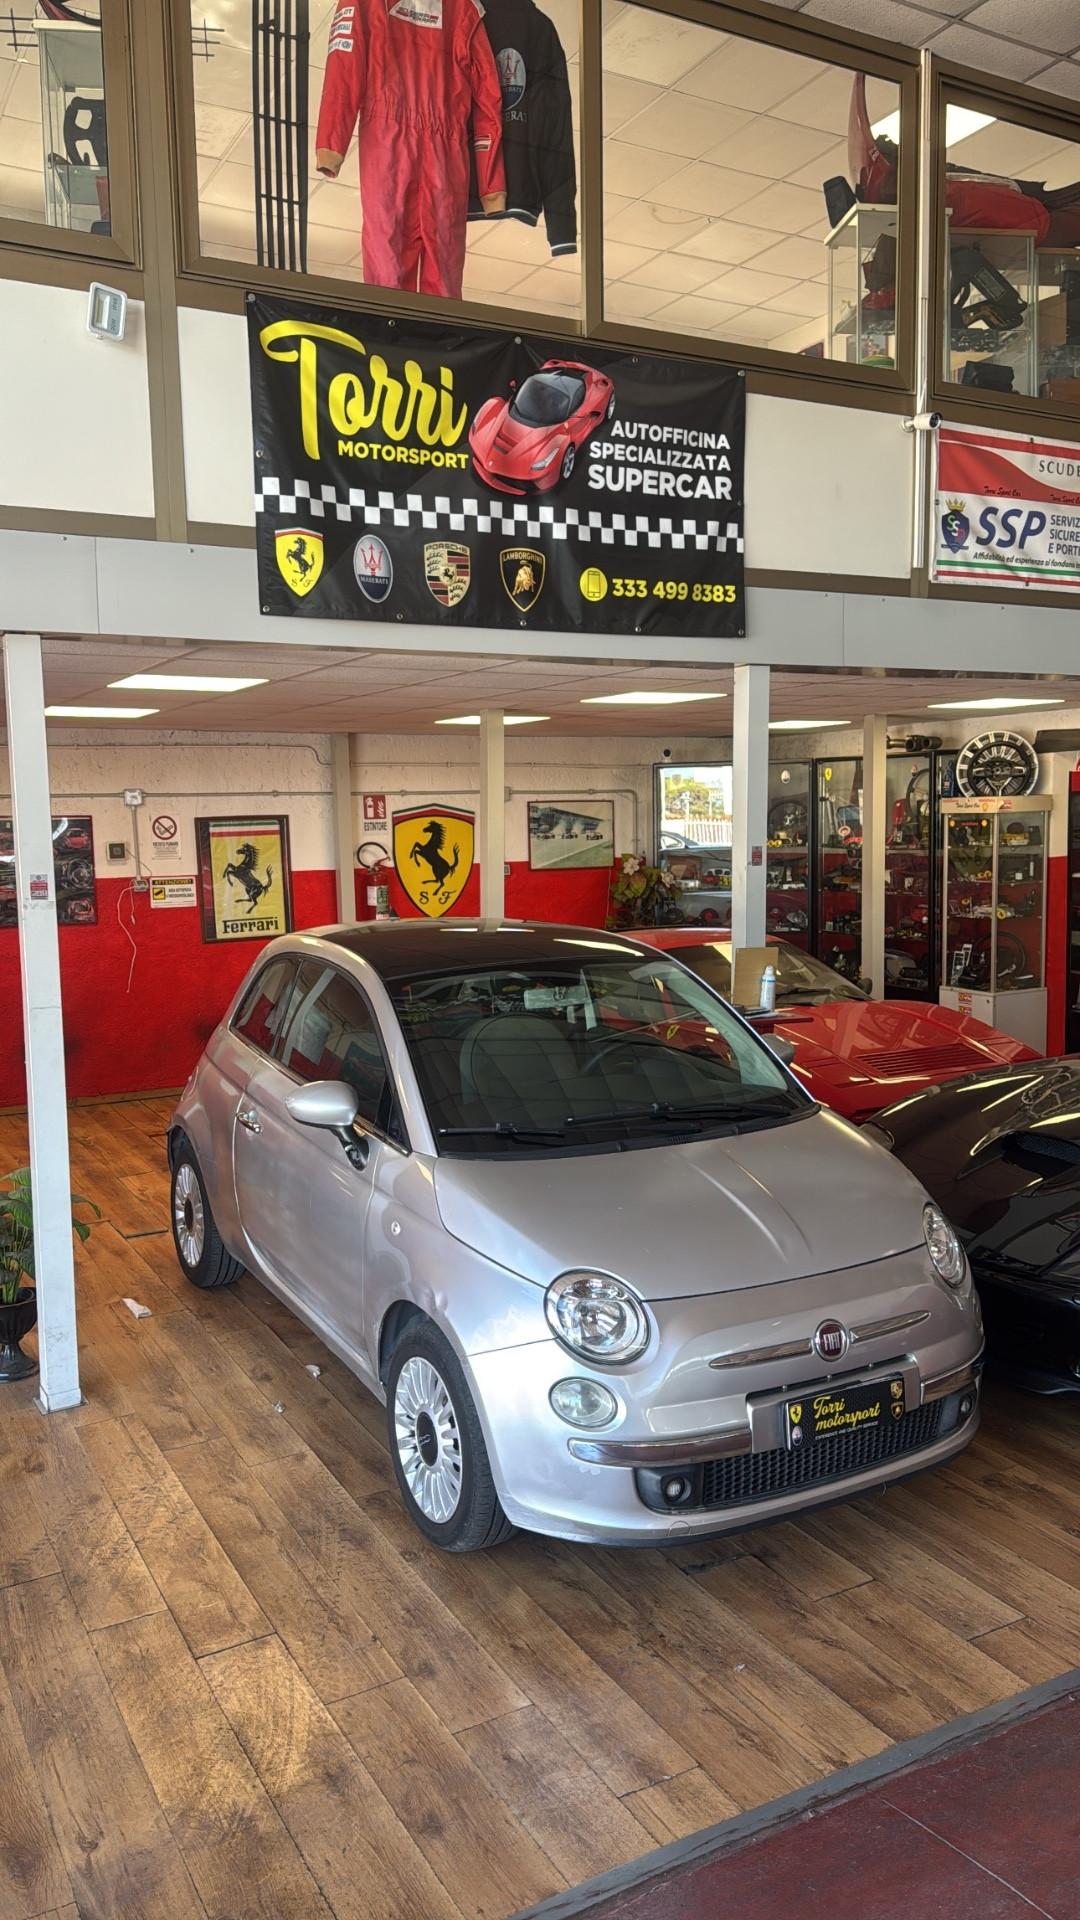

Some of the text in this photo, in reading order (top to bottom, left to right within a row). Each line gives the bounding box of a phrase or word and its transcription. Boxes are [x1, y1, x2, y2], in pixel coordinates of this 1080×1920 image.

[260, 320, 468, 460] Torri
[611, 420, 731, 450] AUTOFFICINA
[338, 439, 469, 469] MOTORSPORT
[589, 441, 731, 471] SPECIALIZZATA
[588, 464, 732, 500] SUPERCAR
[976, 506, 1046, 549] SSP
[425, 543, 469, 554] PORSCHE
[503, 551, 543, 564] LAMBORGHINI
[1006, 554, 1015, 563] ed
[1048, 542, 1054, 554] E
[359, 575, 389, 585] MASERATI
[611, 578, 736, 603] 333 499 8383
[364, 822, 387, 832] ESTINTORE
[419, 891, 429, 905] S
[222, 916, 279, 935] Ferrari
[823, 1332, 840, 1351] FIAT
[813, 1395, 845, 1419] Torri
[815, 1402, 880, 1432] motorsport
